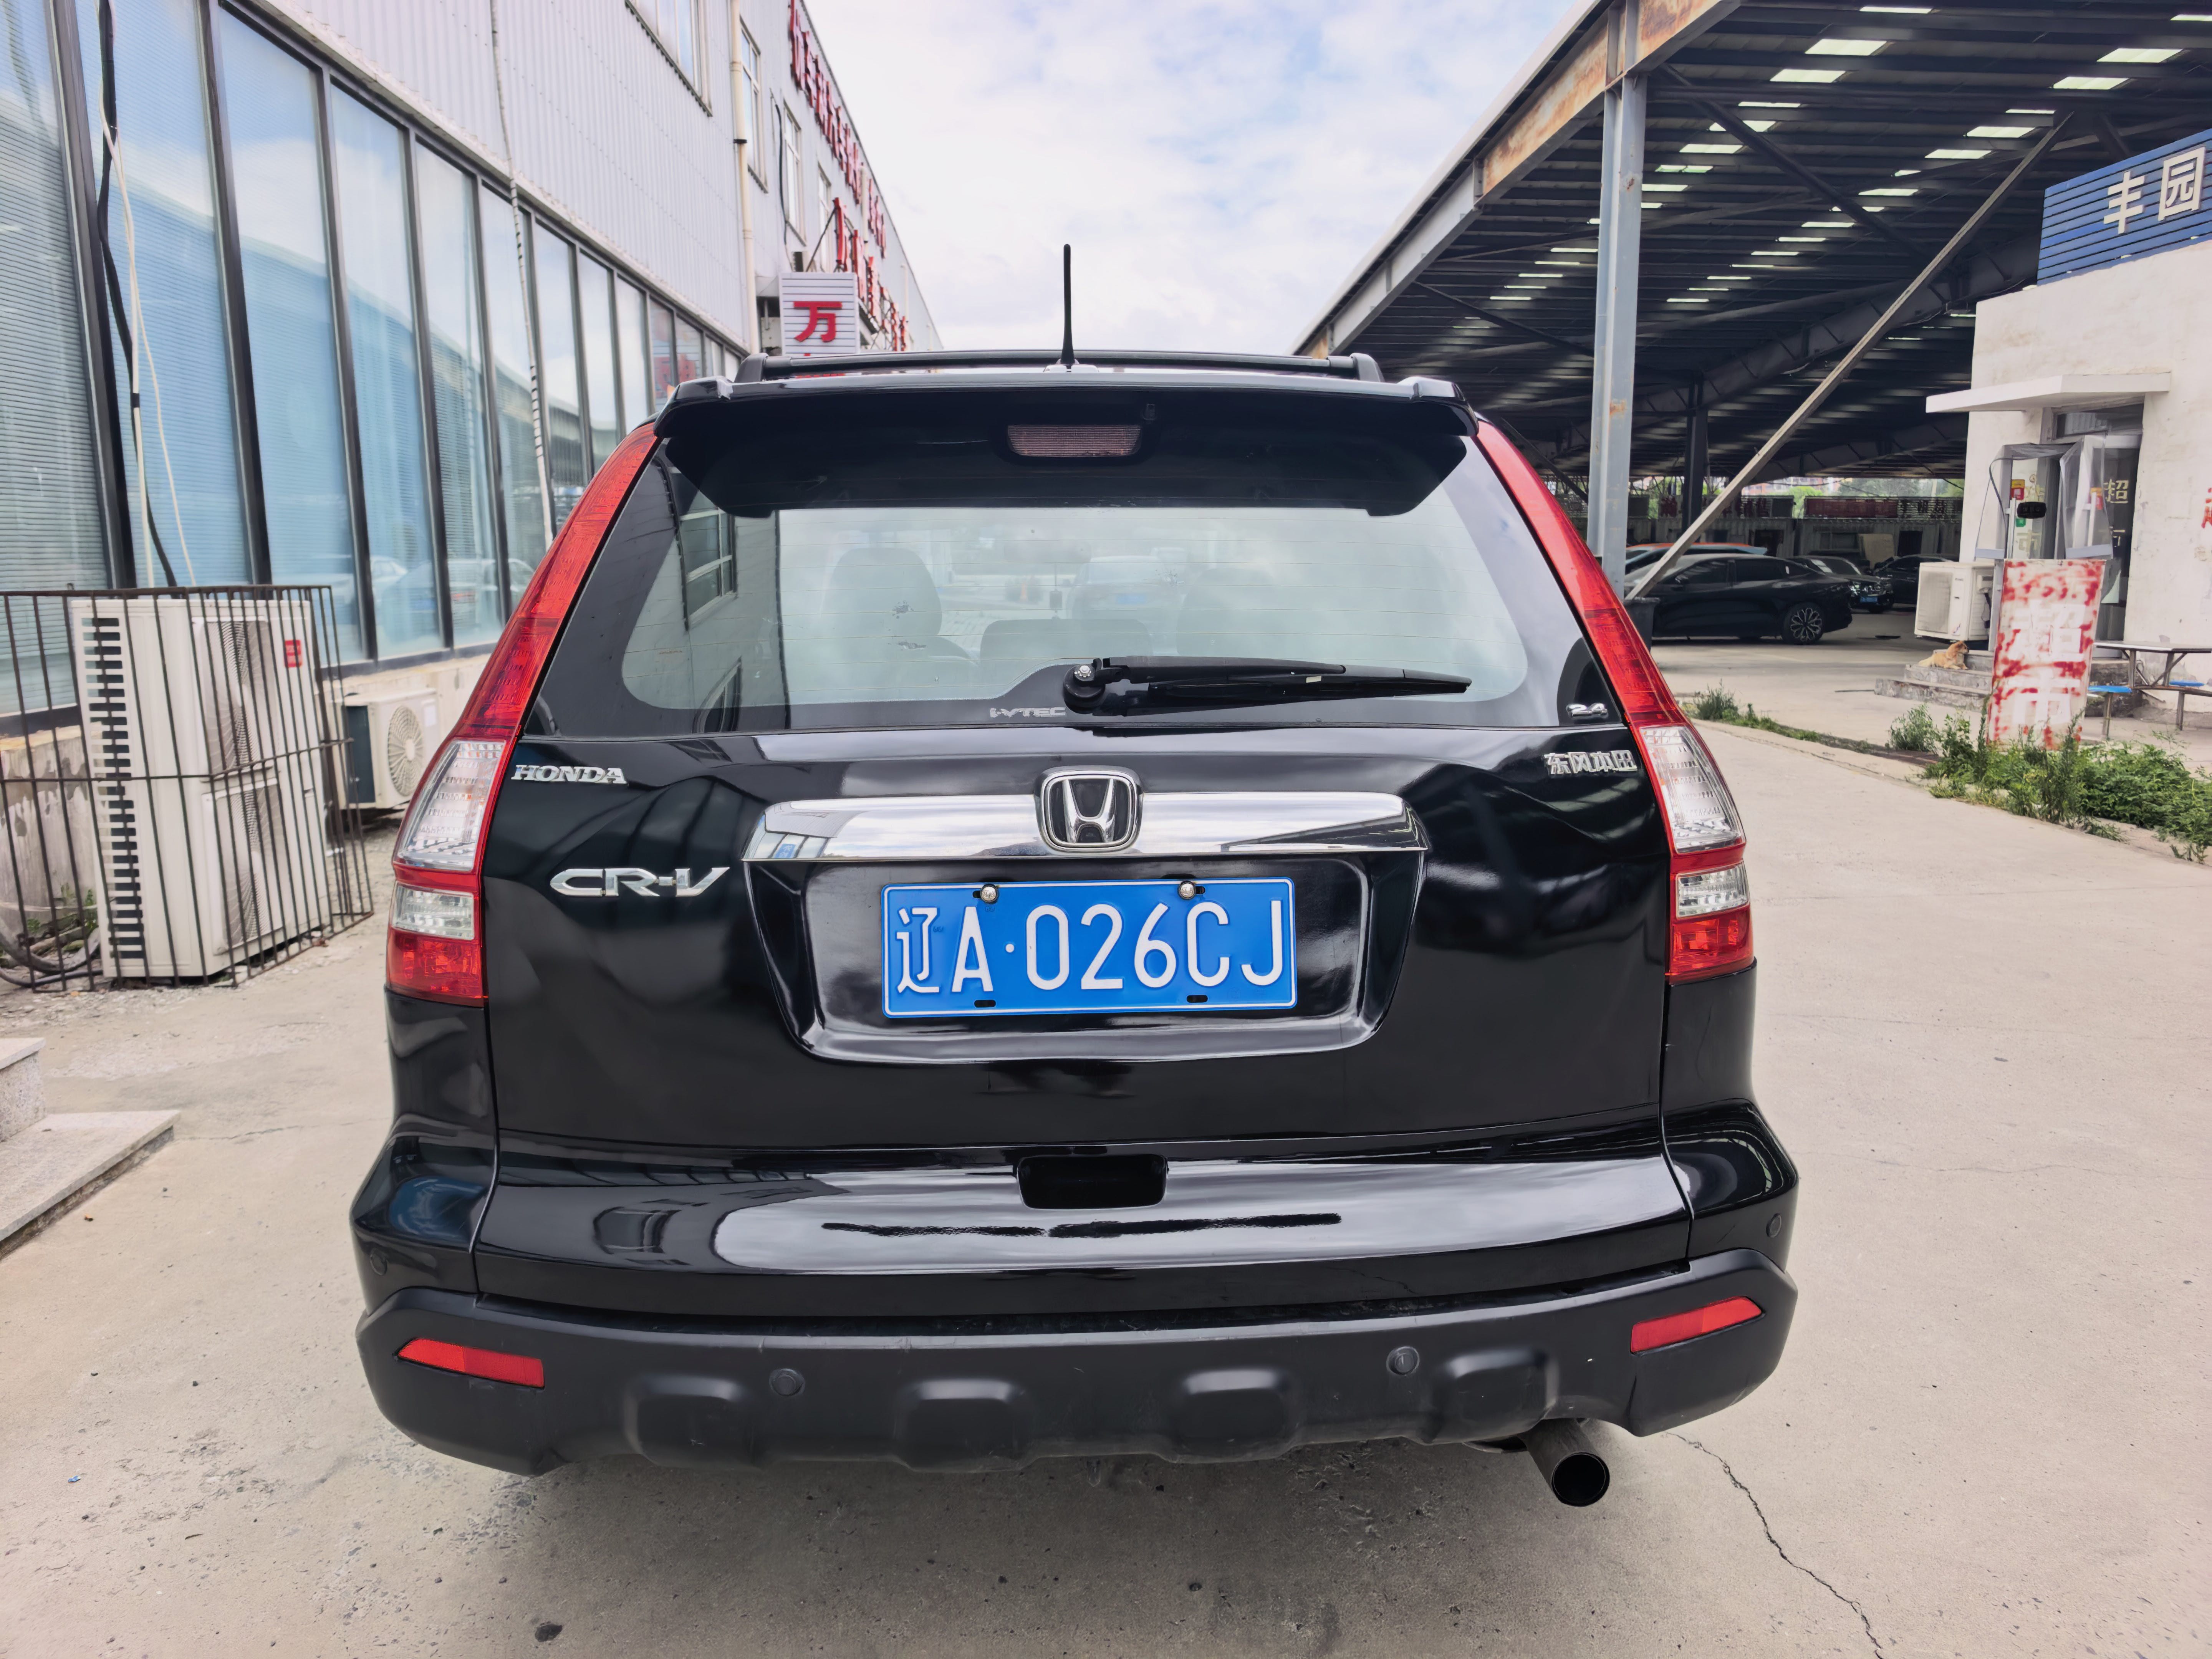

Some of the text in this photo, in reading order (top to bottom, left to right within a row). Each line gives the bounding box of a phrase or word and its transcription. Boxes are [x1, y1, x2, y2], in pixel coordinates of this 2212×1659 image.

[2103, 146, 2206, 234] 丰园
[793, 301, 842, 343] 万
[511, 765, 629, 785] HONDA
[550, 866, 730, 897] CR-V
